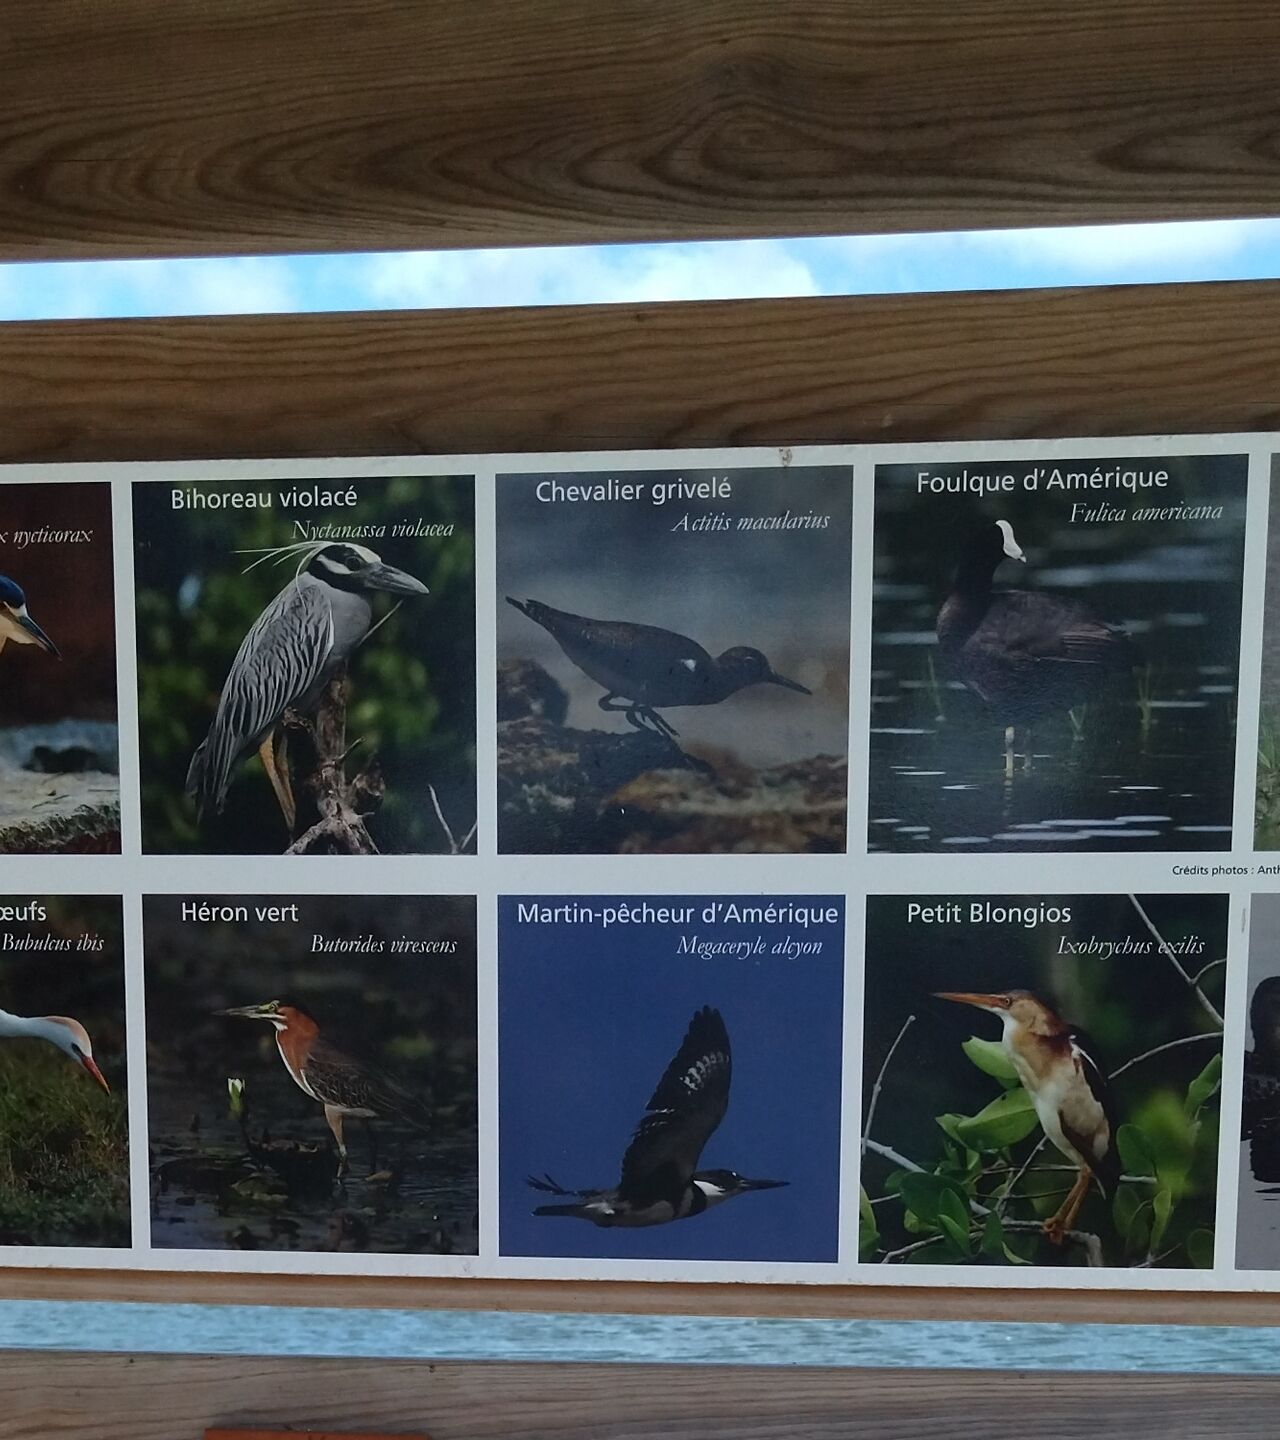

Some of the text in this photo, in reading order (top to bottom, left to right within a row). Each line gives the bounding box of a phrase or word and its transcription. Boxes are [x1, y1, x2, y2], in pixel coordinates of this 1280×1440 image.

[535, 476, 732, 508] Chevalier grivelé
[917, 469, 1016, 500] Foulque
[171, 486, 358, 511] Bihoreau violacé
[671, 511, 831, 534] Actitis macularius
[1069, 501, 1224, 525] Fulica americana
[11, 525, 94, 549] nycticorax
[291, 519, 455, 543] Nyctanassa violacea
[1172, 864, 1209, 876] Crédits
[1211, 863, 1248, 878] photos
[181, 900, 299, 922] Héron vert
[517, 901, 695, 930] Martin-pêcheur
[907, 901, 1073, 931] Petit Blongios
[1, 931, 105, 952] Bubulcus ibis
[309, 933, 458, 955] Butorides virescens
[676, 935, 823, 959] Megaceryle alcyon
[1056, 935, 1206, 959] Ixobrychus exilis
